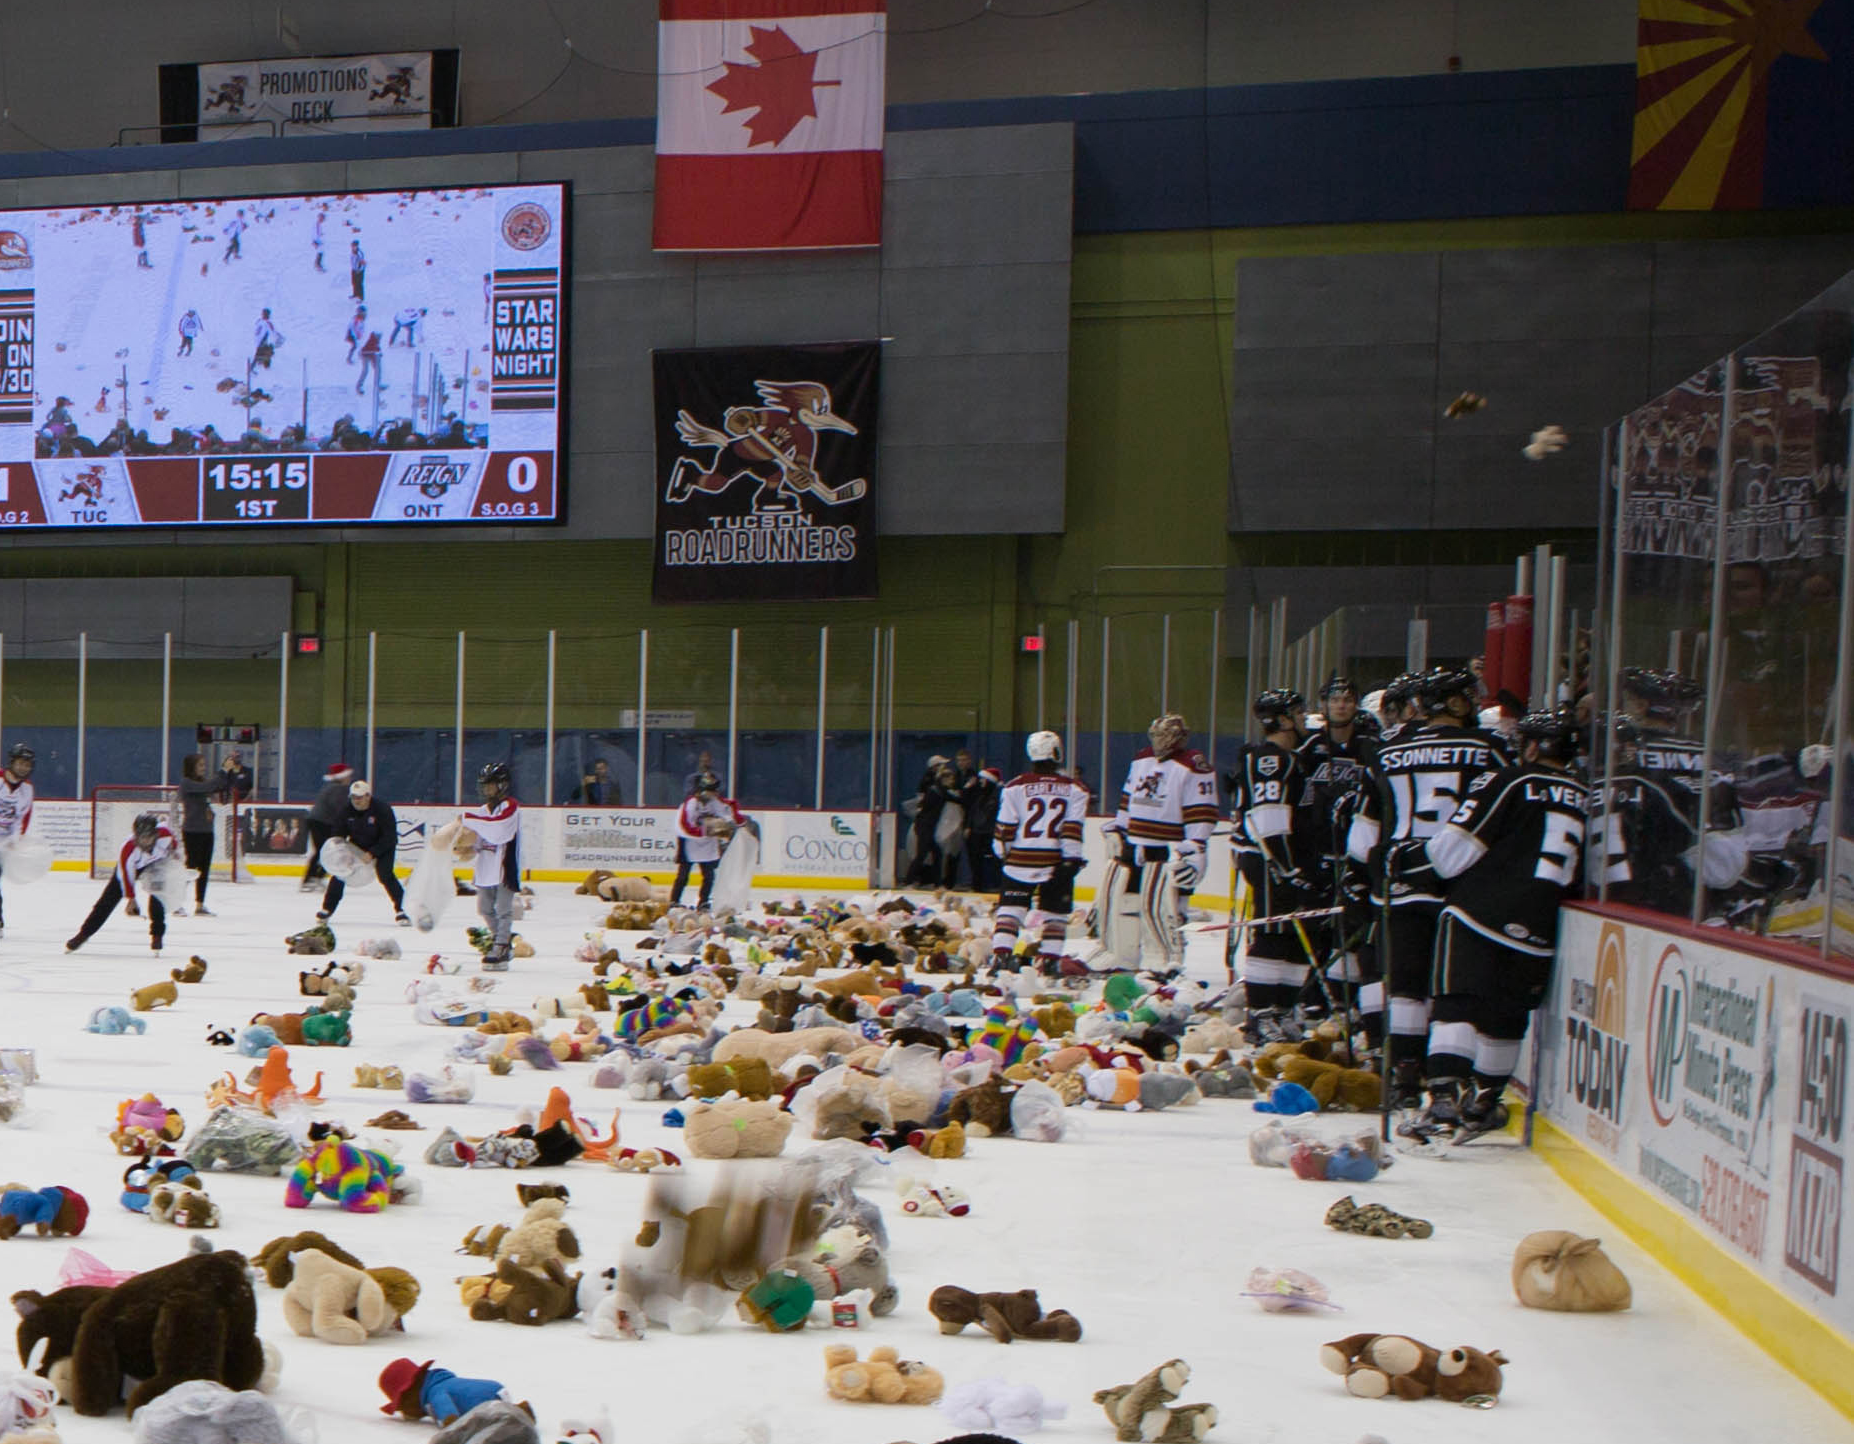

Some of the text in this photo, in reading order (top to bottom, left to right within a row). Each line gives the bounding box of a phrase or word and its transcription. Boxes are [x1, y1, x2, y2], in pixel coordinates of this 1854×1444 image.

[259, 67, 368, 95] PROMOTIONS
[291, 99, 334, 123] DECK
[496, 301, 553, 323] STAR
[495, 327, 553, 350] WARS
[7, 344, 33, 367] ON
[494, 353, 554, 376] NIGHT
[209, 463, 307, 491] 15:15
[507, 456, 538, 493] 0
[20, 511, 29, 523] 2
[71, 510, 108, 523] TUC
[235, 500, 278, 517] 1ST
[403, 504, 444, 518] ONT
[529, 502, 539, 515] 3
[708, 513, 813, 529] TUCSON
[665, 525, 857, 566] ROADRUNNERS
[1254, 780, 1281, 803] 28
[566, 814, 656, 827] GET YOUR
[1024, 797, 1068, 839] 22
[1451, 800, 1478, 824] 5
[640, 838, 677, 850] GEA
[1566, 1016, 1630, 1125] TODAY
